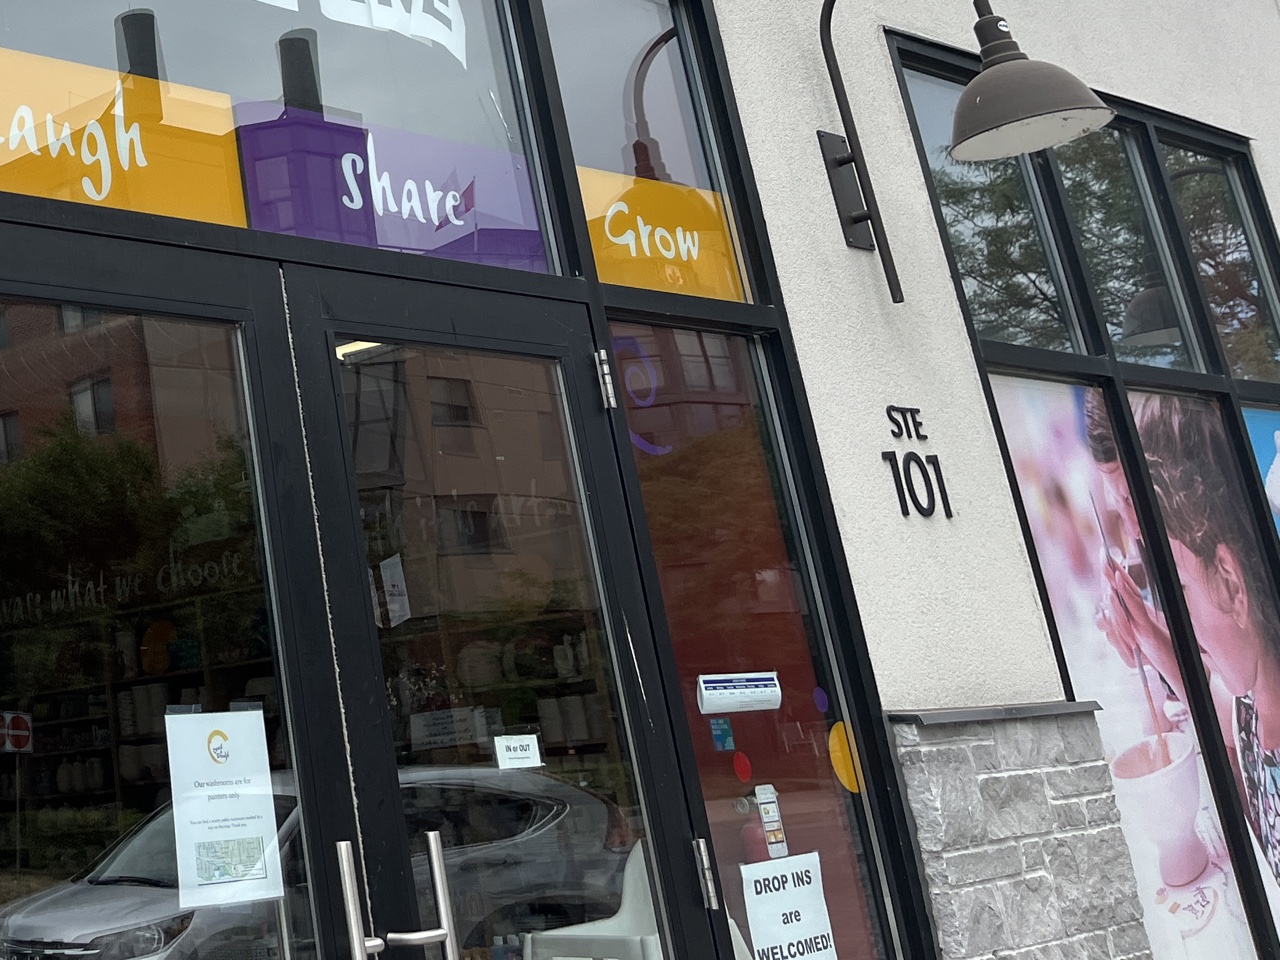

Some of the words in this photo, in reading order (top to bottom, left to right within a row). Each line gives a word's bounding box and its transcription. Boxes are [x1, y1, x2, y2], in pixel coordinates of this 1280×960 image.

[604, 200, 699, 262] Grow
[885, 404, 928, 441] STE
[881, 450, 953, 520] 101
[50, 560, 108, 613] what
[115, 572, 144, 602] we
[519, 743, 530, 752] OUT
[753, 873, 788, 895] DROP
[791, 869, 812, 888] INS
[781, 909, 802, 925] are
[756, 932, 833, 960] WELCOMED!
